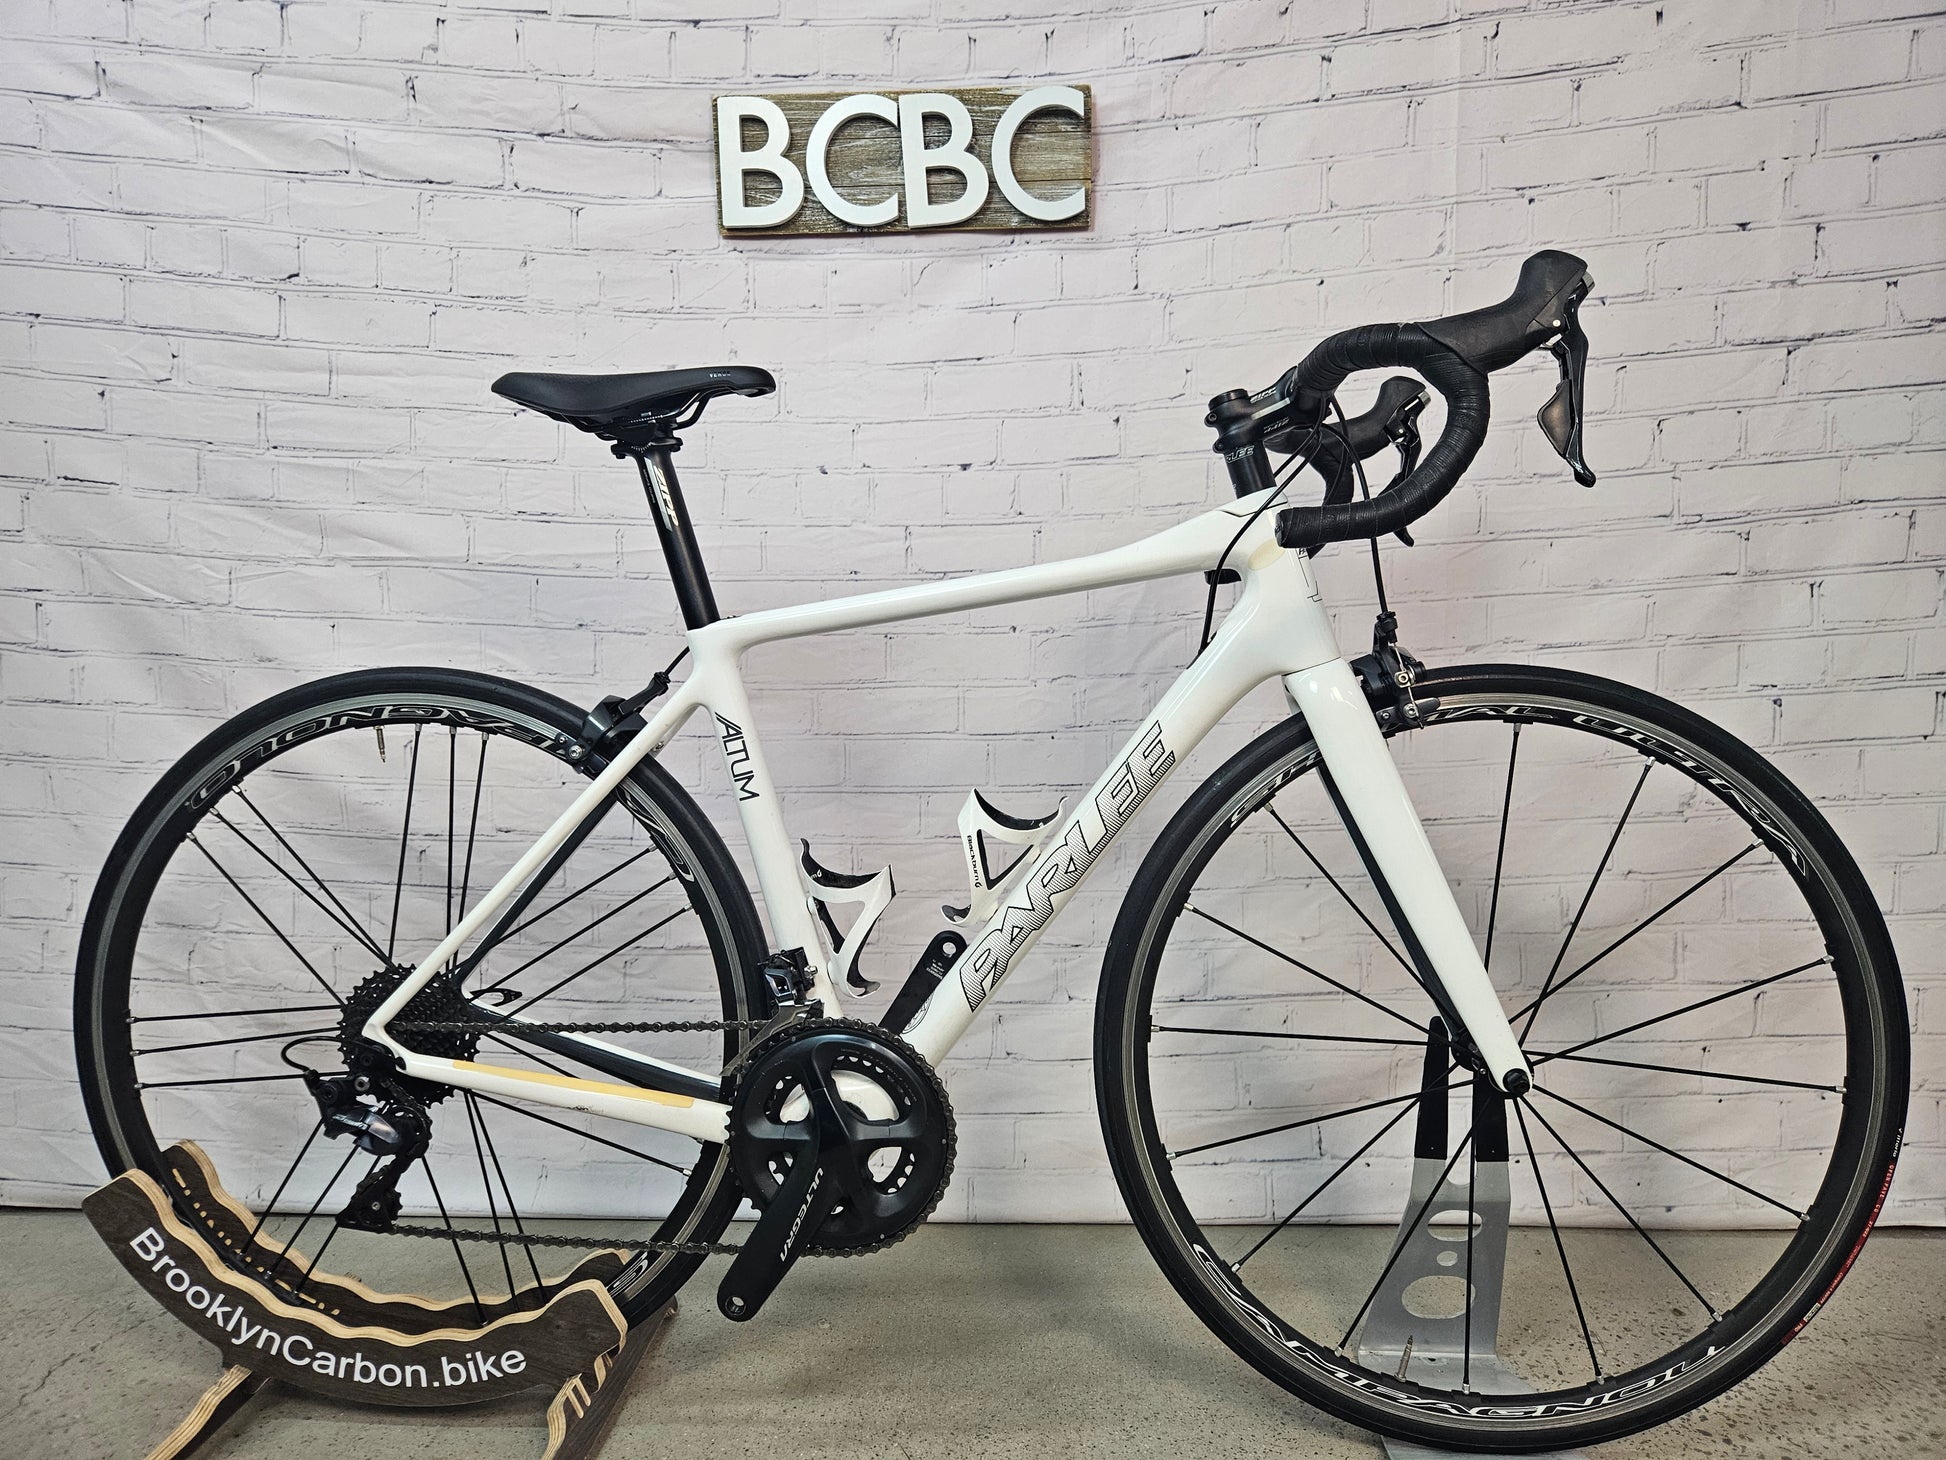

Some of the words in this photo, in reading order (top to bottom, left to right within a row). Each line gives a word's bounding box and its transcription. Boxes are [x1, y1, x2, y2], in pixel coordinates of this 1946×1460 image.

[717, 86, 1086, 229] BCBC
[190, 704, 695, 883] CAPAGNOLO
[714, 711, 761, 802] ALTUM
[959, 720, 1176, 1013] PARLEE
[779, 1167, 824, 1262] ULTEGRA
[129, 1227, 527, 1388] BrooklynCarbon.bike
